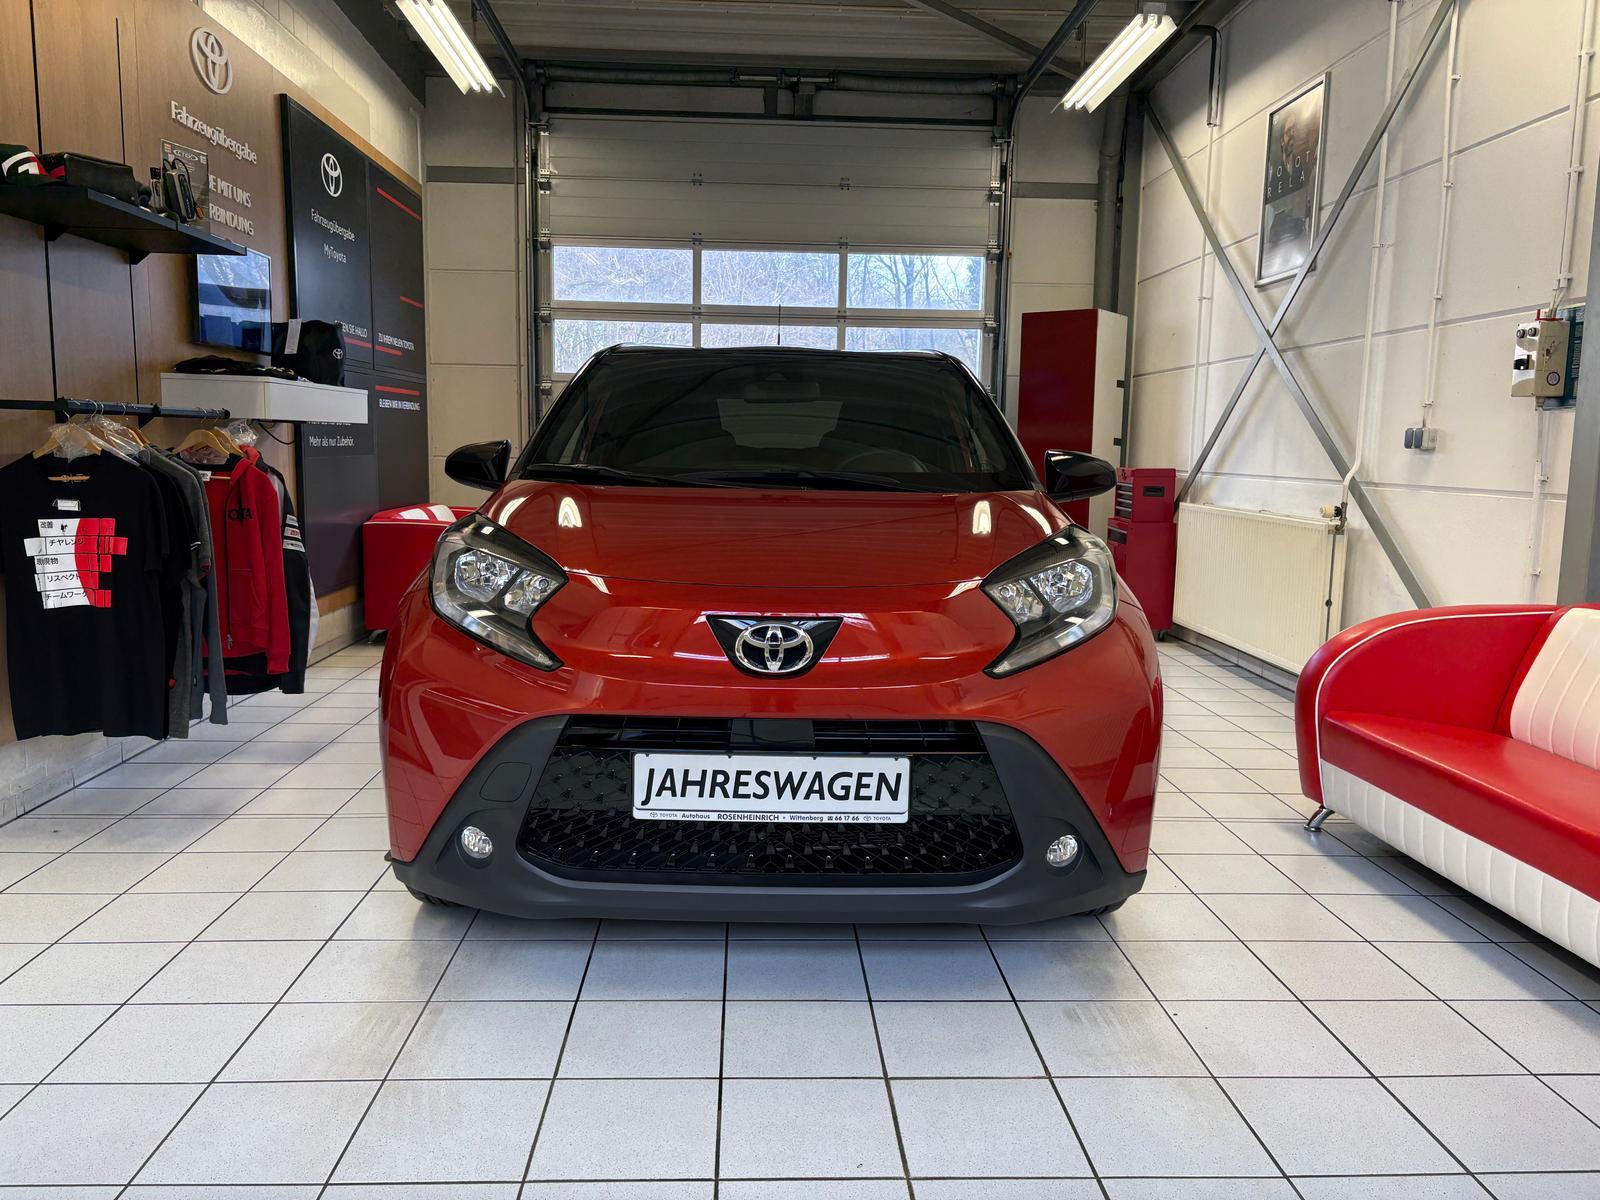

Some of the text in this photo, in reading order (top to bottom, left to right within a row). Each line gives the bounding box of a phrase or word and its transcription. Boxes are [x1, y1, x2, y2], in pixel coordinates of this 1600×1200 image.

[171, 100, 257, 165] Fahrzeugübergabe
[217, 178, 232, 200] MIT
[233, 187, 252, 209] UNS
[209, 203, 254, 236] RBINDUNG
[311, 208, 356, 241] Fahrzeugübergabe
[323, 243, 347, 263] MyToyota
[309, 435, 321, 447] Mehr
[641, 767, 902, 807] JAHRESWAGEN
[681, 812, 711, 820] Autohaus
[717, 813, 780, 822] ROSENHEINRICH
[789, 814, 824, 823] Wittenberg
